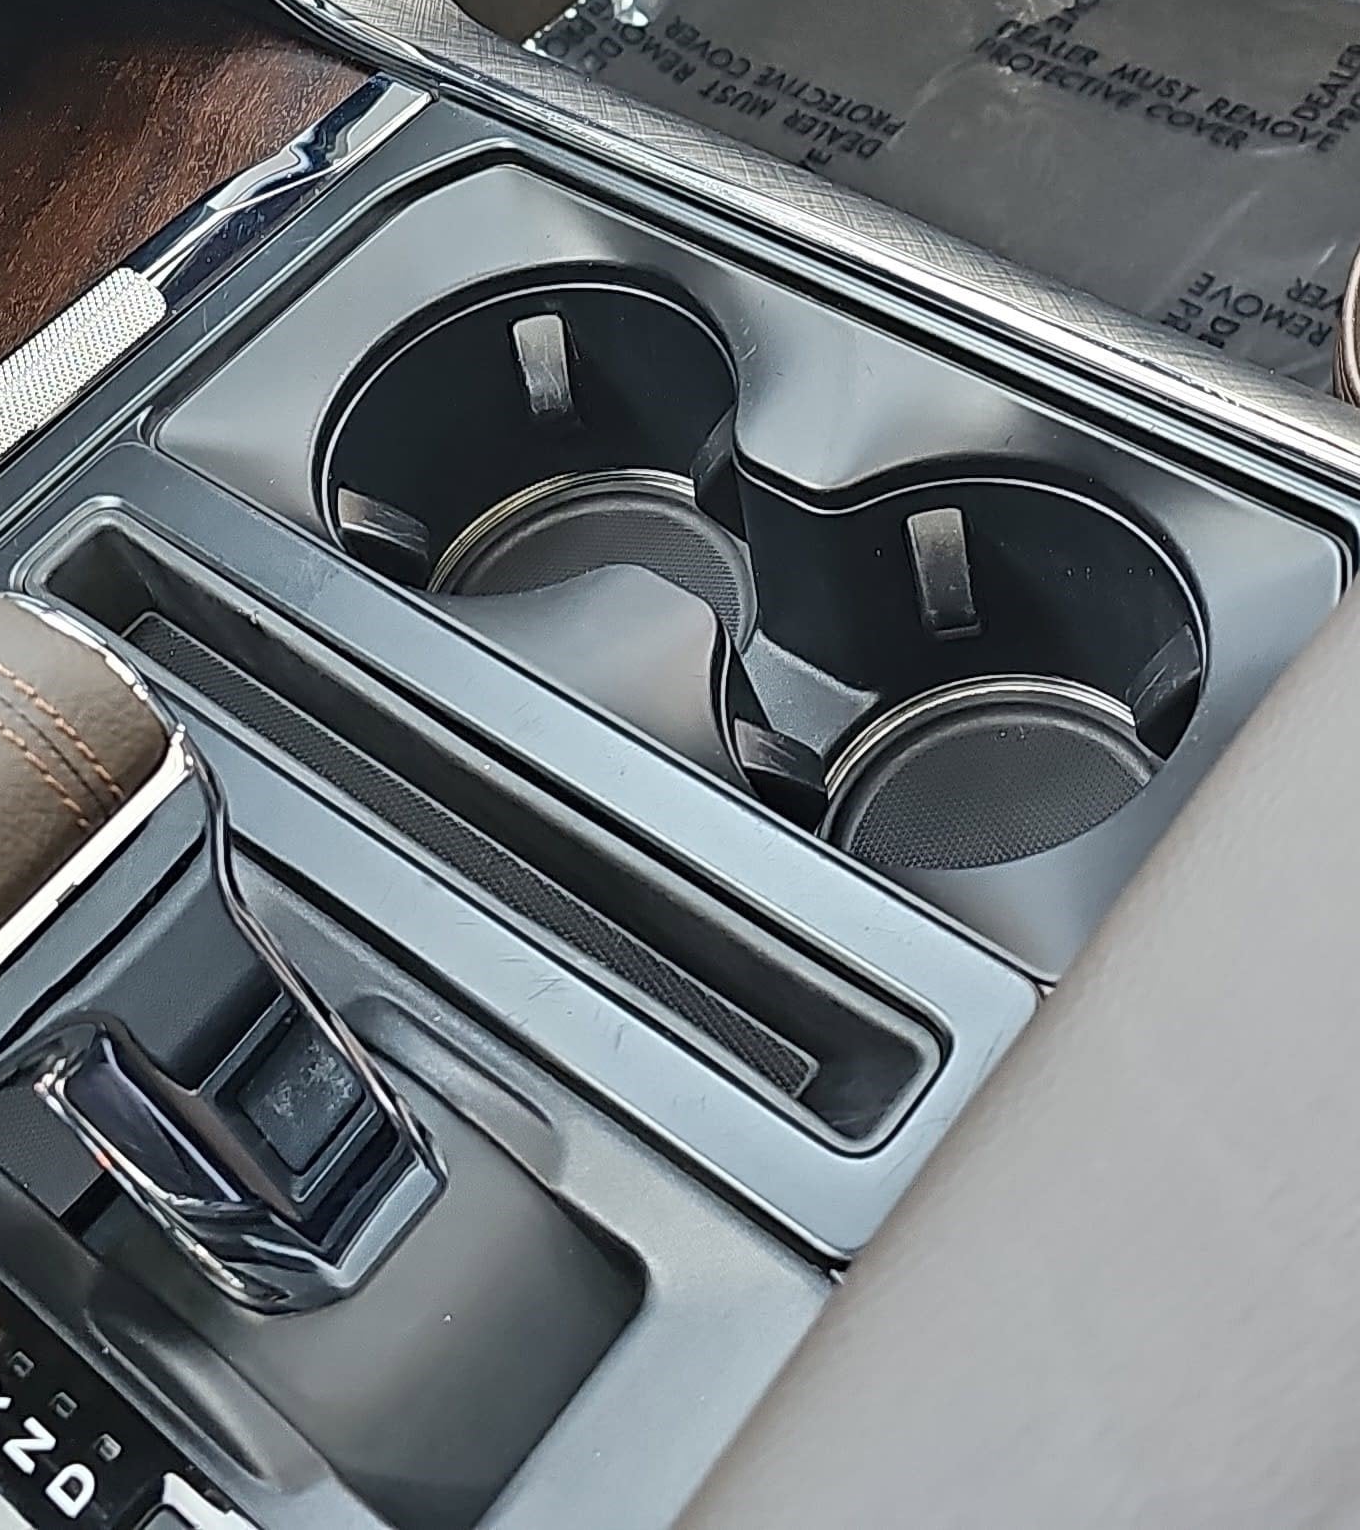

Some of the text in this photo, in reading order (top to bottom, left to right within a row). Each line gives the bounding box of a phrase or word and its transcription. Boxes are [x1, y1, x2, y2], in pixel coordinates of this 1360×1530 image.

[665, 15, 752, 81] COVER
[696, 78, 778, 119] MUST
[755, 63, 908, 138] PROTECTIVE
[973, 37, 1250, 152] PROTECTIVE COVER
[1107, 62, 1202, 106] MUST
[1204, 96, 1341, 152] REMOVE
[782, 108, 887, 162] DEALER
[1187, 270, 1333, 349] REMOVE
[1, 1415, 57, 1476] N
[45, 1462, 96, 1520] D
